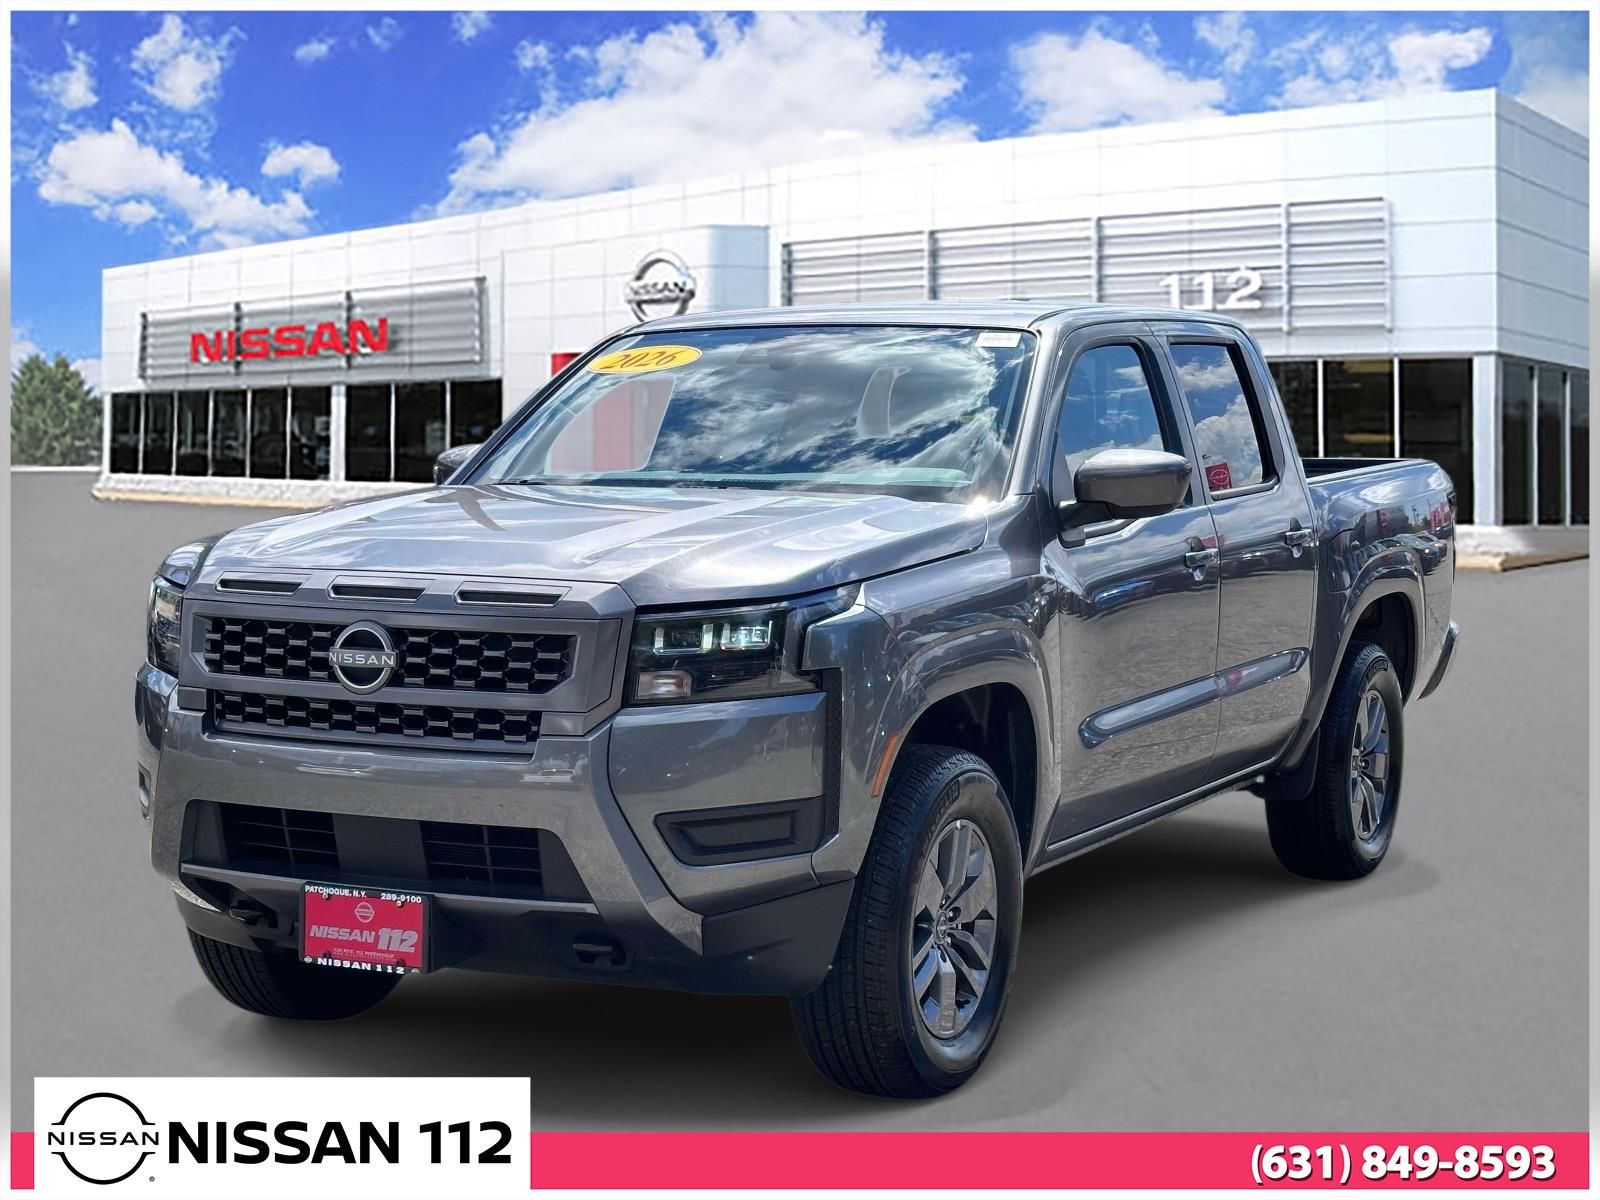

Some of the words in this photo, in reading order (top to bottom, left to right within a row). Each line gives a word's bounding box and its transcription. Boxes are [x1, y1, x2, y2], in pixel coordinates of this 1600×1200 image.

[1158, 268, 1262, 311] 112
[190, 317, 389, 364] NISSAN
[600, 350, 686, 370] 2026
[329, 652, 394, 665] NISSAN
[304, 885, 352, 896] PATCHOGUE,
[353, 890, 367, 898] N.Y.
[380, 893, 422, 903] 289-9100
[310, 924, 376, 943] NISSAN
[377, 928, 418, 953] 112
[317, 957, 371, 970] NISSAN
